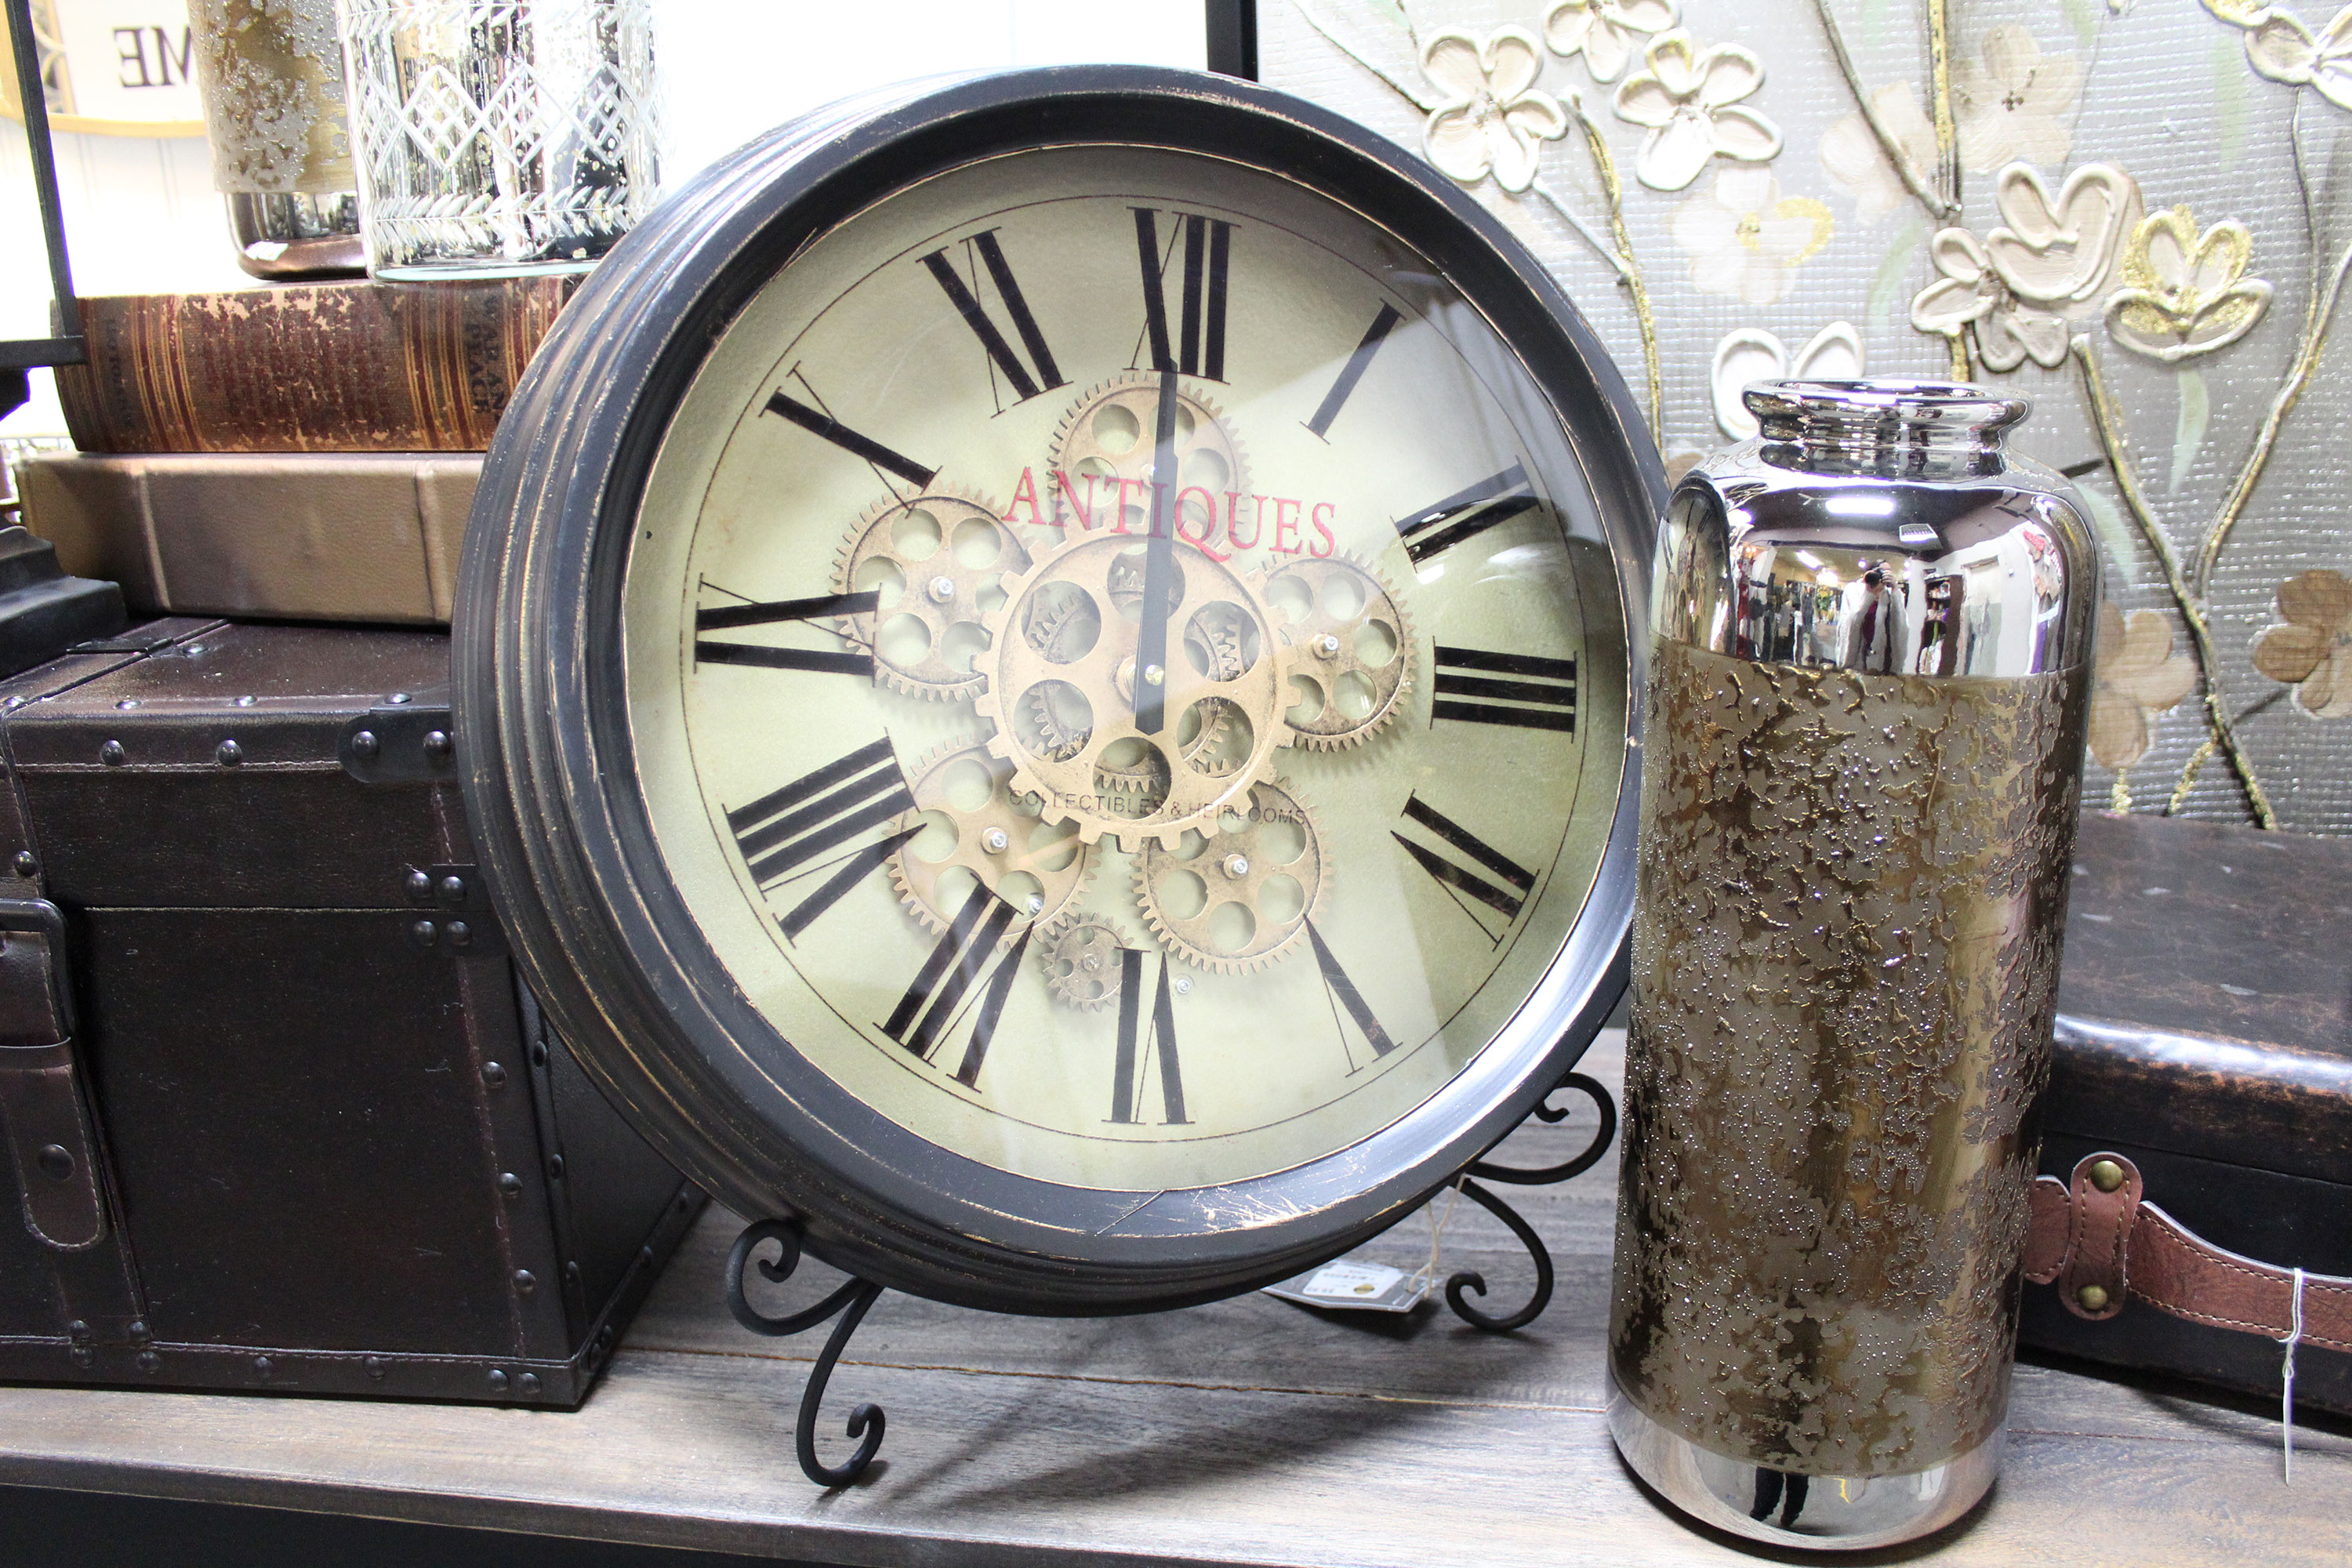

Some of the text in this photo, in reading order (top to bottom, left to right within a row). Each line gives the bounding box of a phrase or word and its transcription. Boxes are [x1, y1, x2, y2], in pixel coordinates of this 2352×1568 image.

[464, 322, 491, 414] PEACE
[483, 295, 500, 362] WAR
[916, 227, 1073, 418] XI
[1123, 206, 1241, 384] XII
[759, 361, 942, 518] X
[1300, 298, 1406, 445] I
[1001, 466, 1335, 562] ANTIQUES
[1390, 456, 1544, 573] II
[695, 572, 882, 687] IX
[1430, 636, 1577, 743] III
[722, 727, 927, 949] VIII
[1010, 789, 1163, 815] COLLECTIBLES
[1189, 804, 1308, 826] HEIRLOOMS
[1391, 789, 1540, 952] IV
[873, 873, 1033, 1093] VII
[1102, 947, 1196, 1125] VI
[1303, 913, 1403, 1077] V
